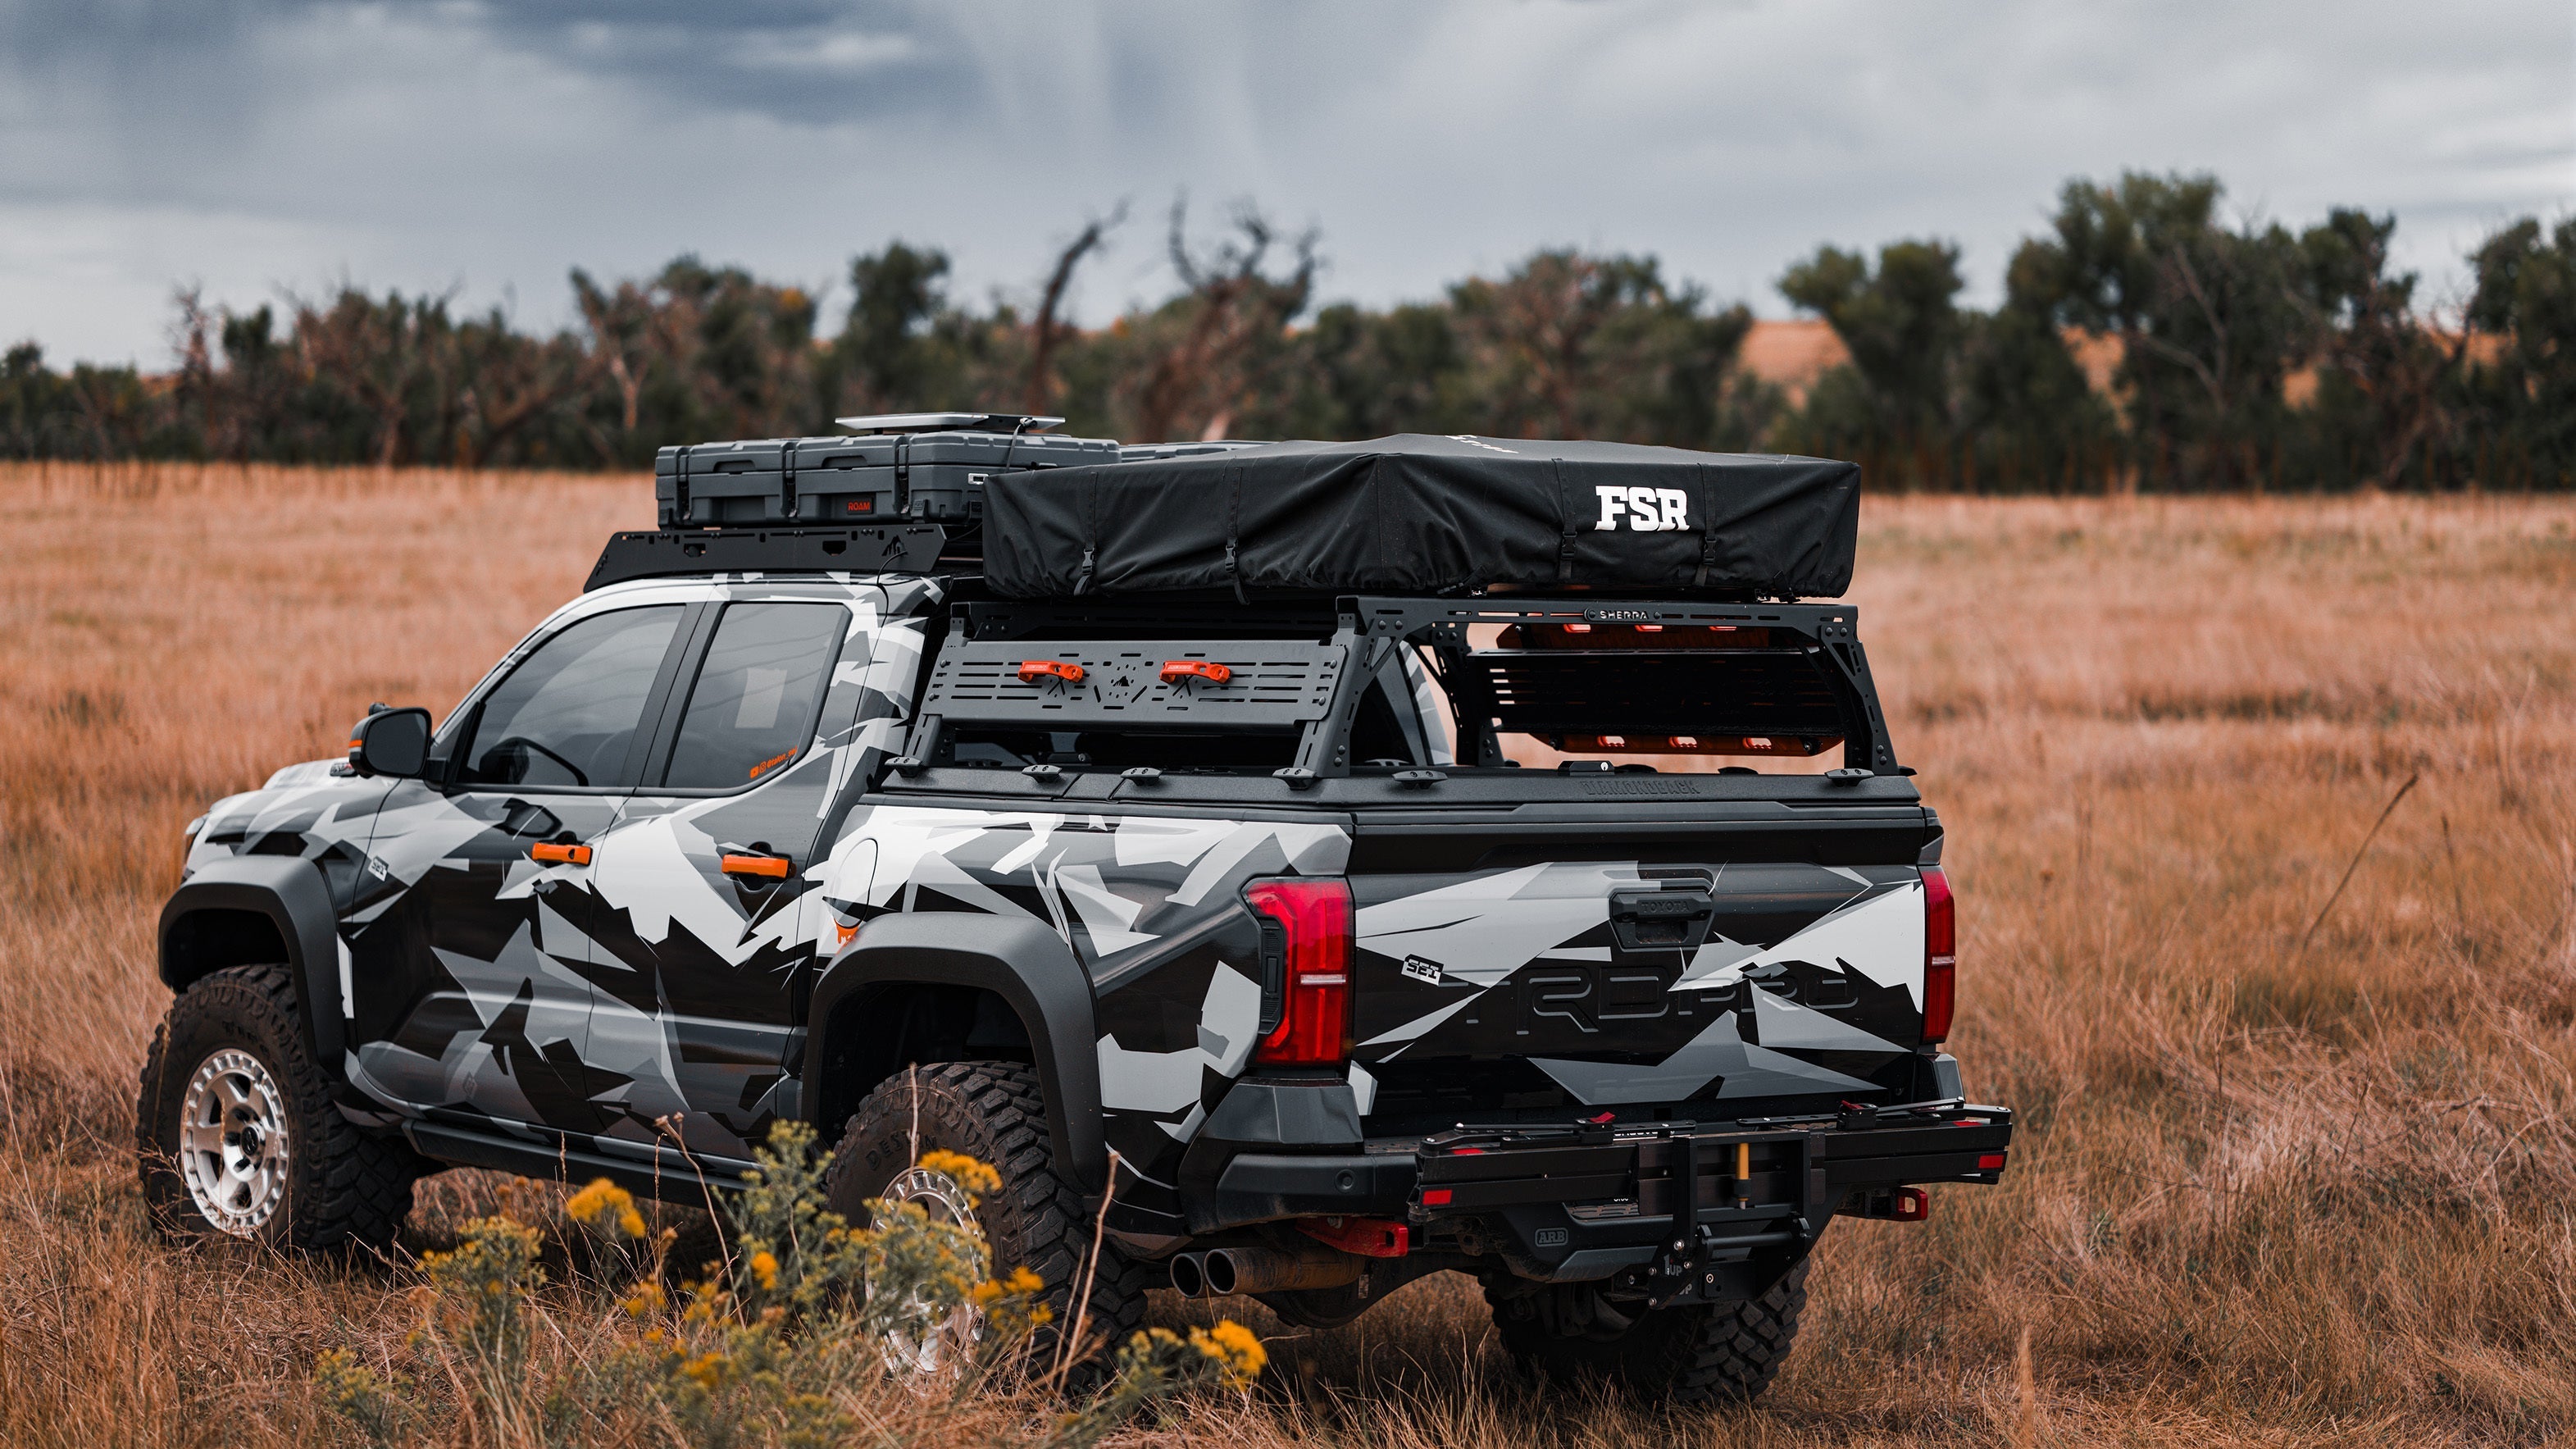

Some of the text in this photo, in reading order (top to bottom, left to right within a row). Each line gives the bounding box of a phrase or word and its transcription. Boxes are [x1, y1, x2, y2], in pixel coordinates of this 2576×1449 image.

[848, 501, 871, 511] ROAM
[1595, 485, 1690, 531] FSR
[1600, 610, 1649, 620] SHERPA
[1580, 780, 1701, 795] DIAMONDBACK
[1641, 901, 1690, 913] TOYOTA
[1436, 965, 1859, 1035] TRD PRO
[1538, 1231, 1565, 1243] ARB
